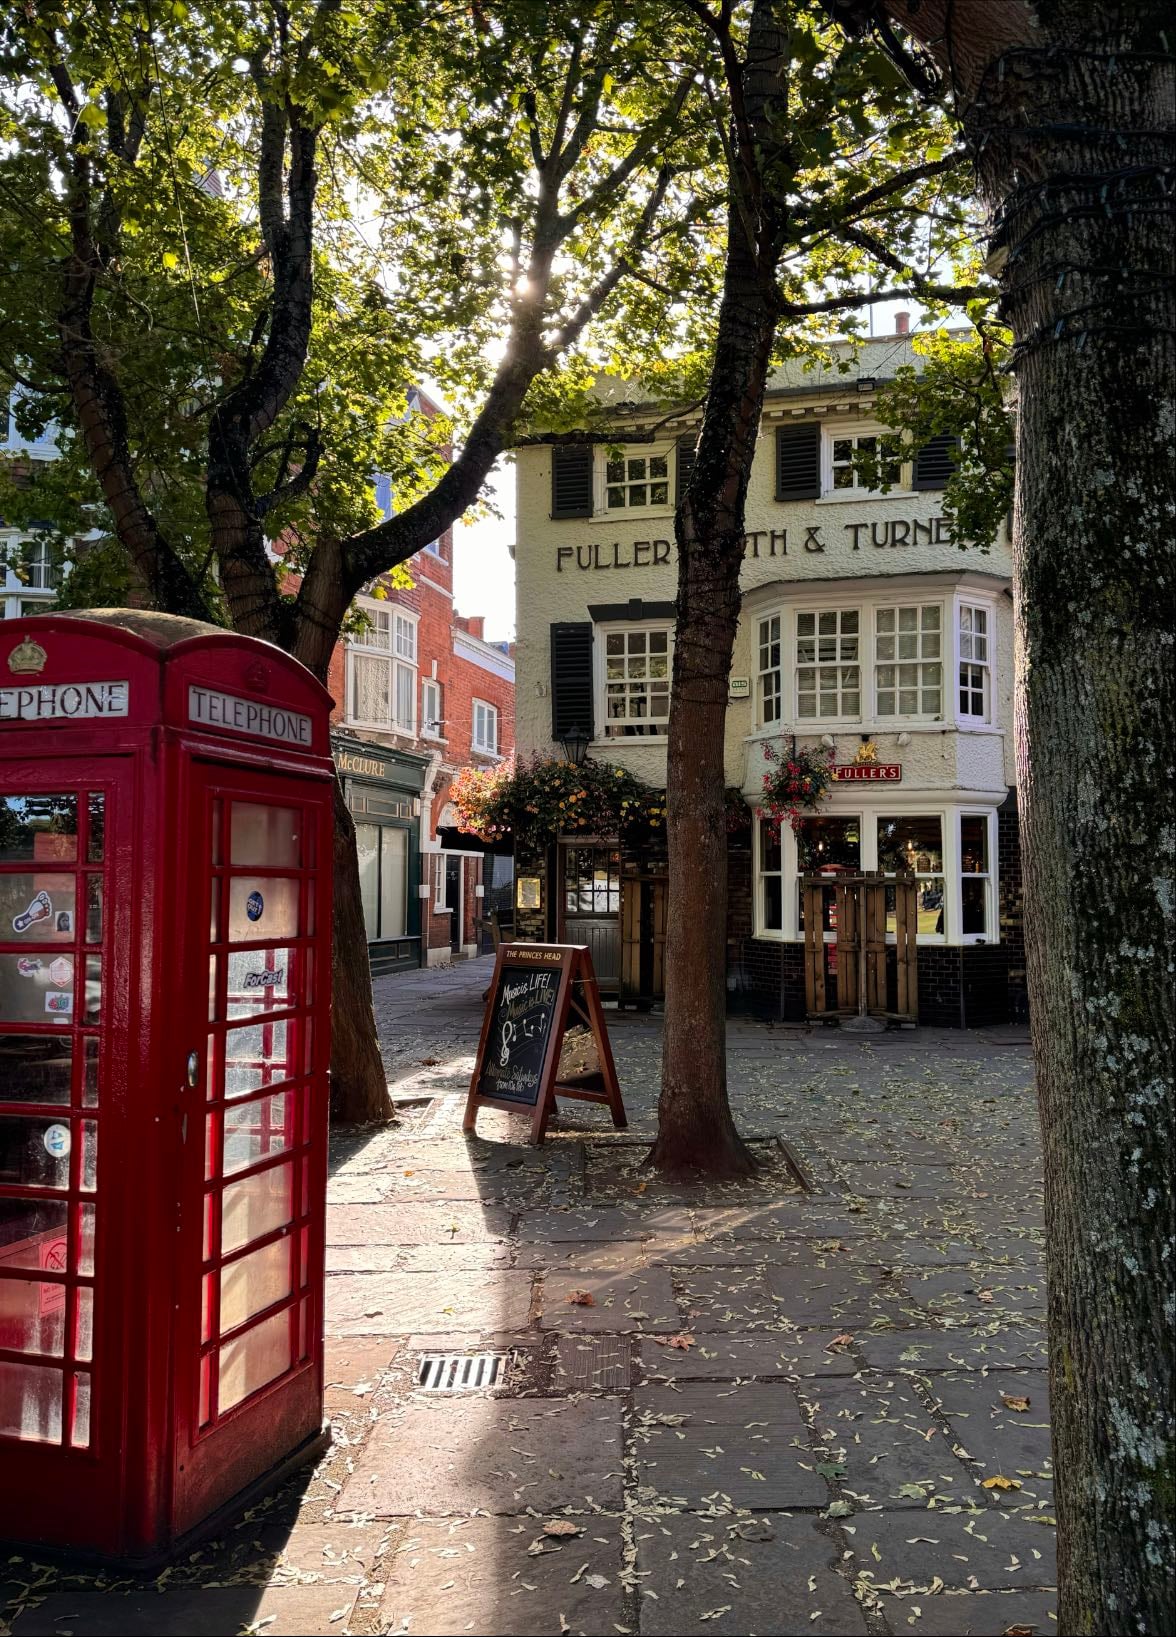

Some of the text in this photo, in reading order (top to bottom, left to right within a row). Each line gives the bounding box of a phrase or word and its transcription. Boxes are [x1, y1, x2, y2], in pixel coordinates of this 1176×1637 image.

[557, 539, 671, 572] FULLER
[804, 526, 826, 553] &
[843, 515, 955, 551] TURNE
[0, 684, 124, 718] EPHONE
[192, 687, 308, 742] TELEPHONE
[338, 752, 385, 777] McCLURE
[836, 766, 896, 779] FULLER'S
[506, 950, 562, 961] THE PRINCES HEAD
[500, 983, 520, 1006] Music
[529, 973, 551, 990] LIFE!
